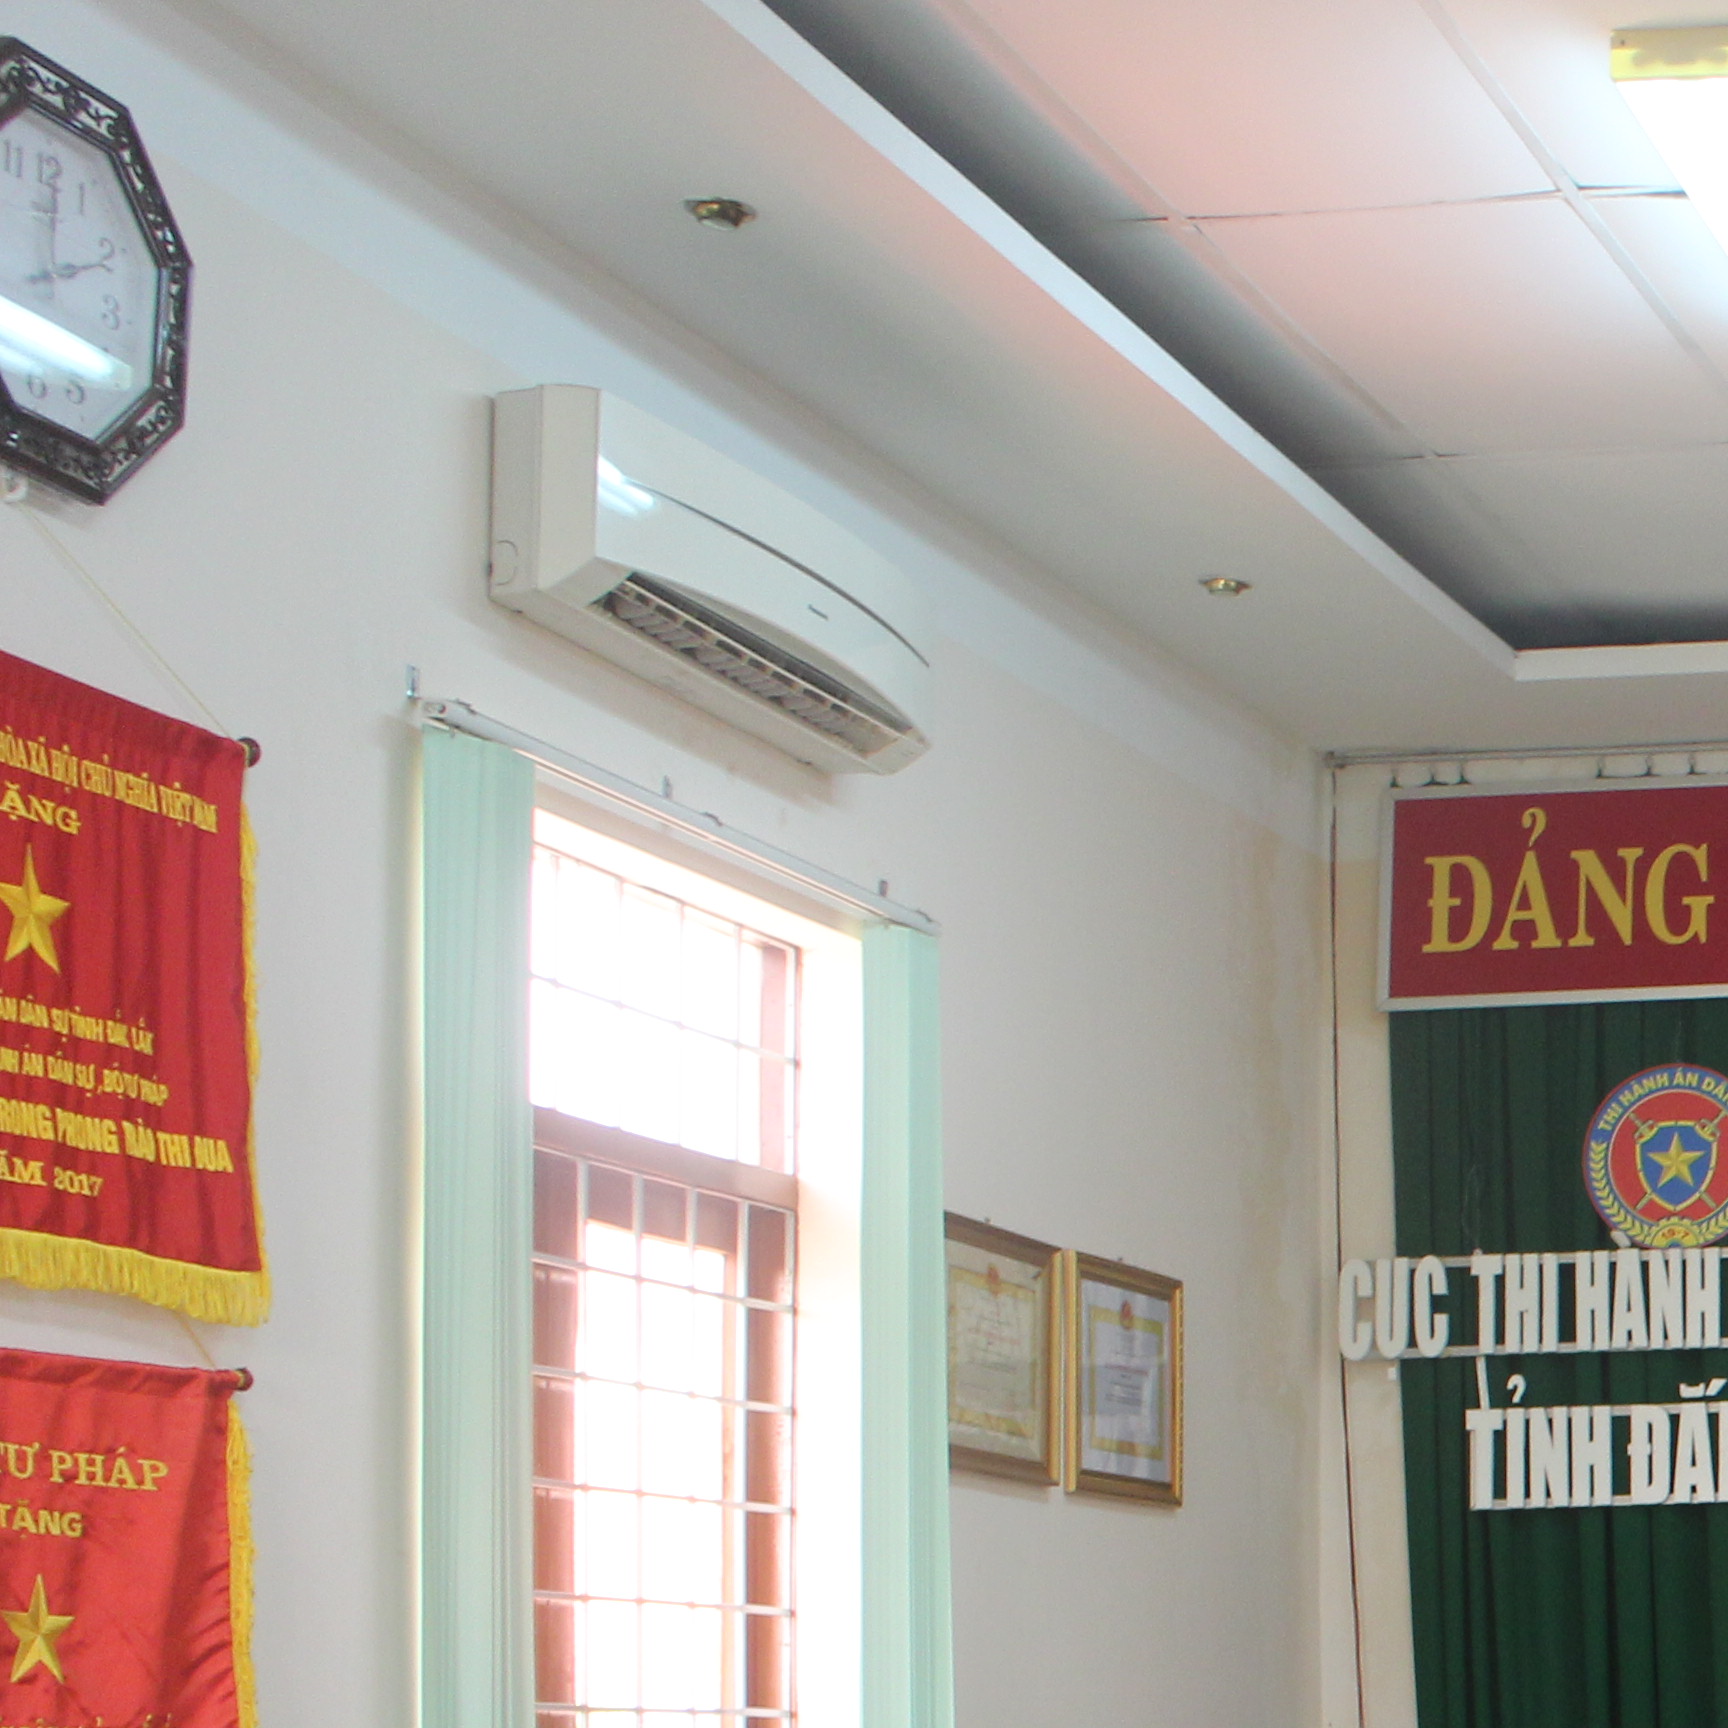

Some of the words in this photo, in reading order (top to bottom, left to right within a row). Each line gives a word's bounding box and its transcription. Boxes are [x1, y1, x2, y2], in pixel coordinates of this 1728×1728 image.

[0, 780, 82, 835] ẶNG
[1422, 807, 1715, 953] ĐẢNG
[1597, 1103, 1624, 1132] THI
[1673, 1067, 1699, 1088] ÁN
[54, 1165, 103, 1197] 2017
[1338, 1255, 1449, 1381] CỤC
[1470, 1252, 1559, 1354] THI
[1575, 1229, 1720, 1352] HÀNH
[49, 1446, 169, 1491] PHÁP
[1466, 1373, 1612, 1511] TỈNH
